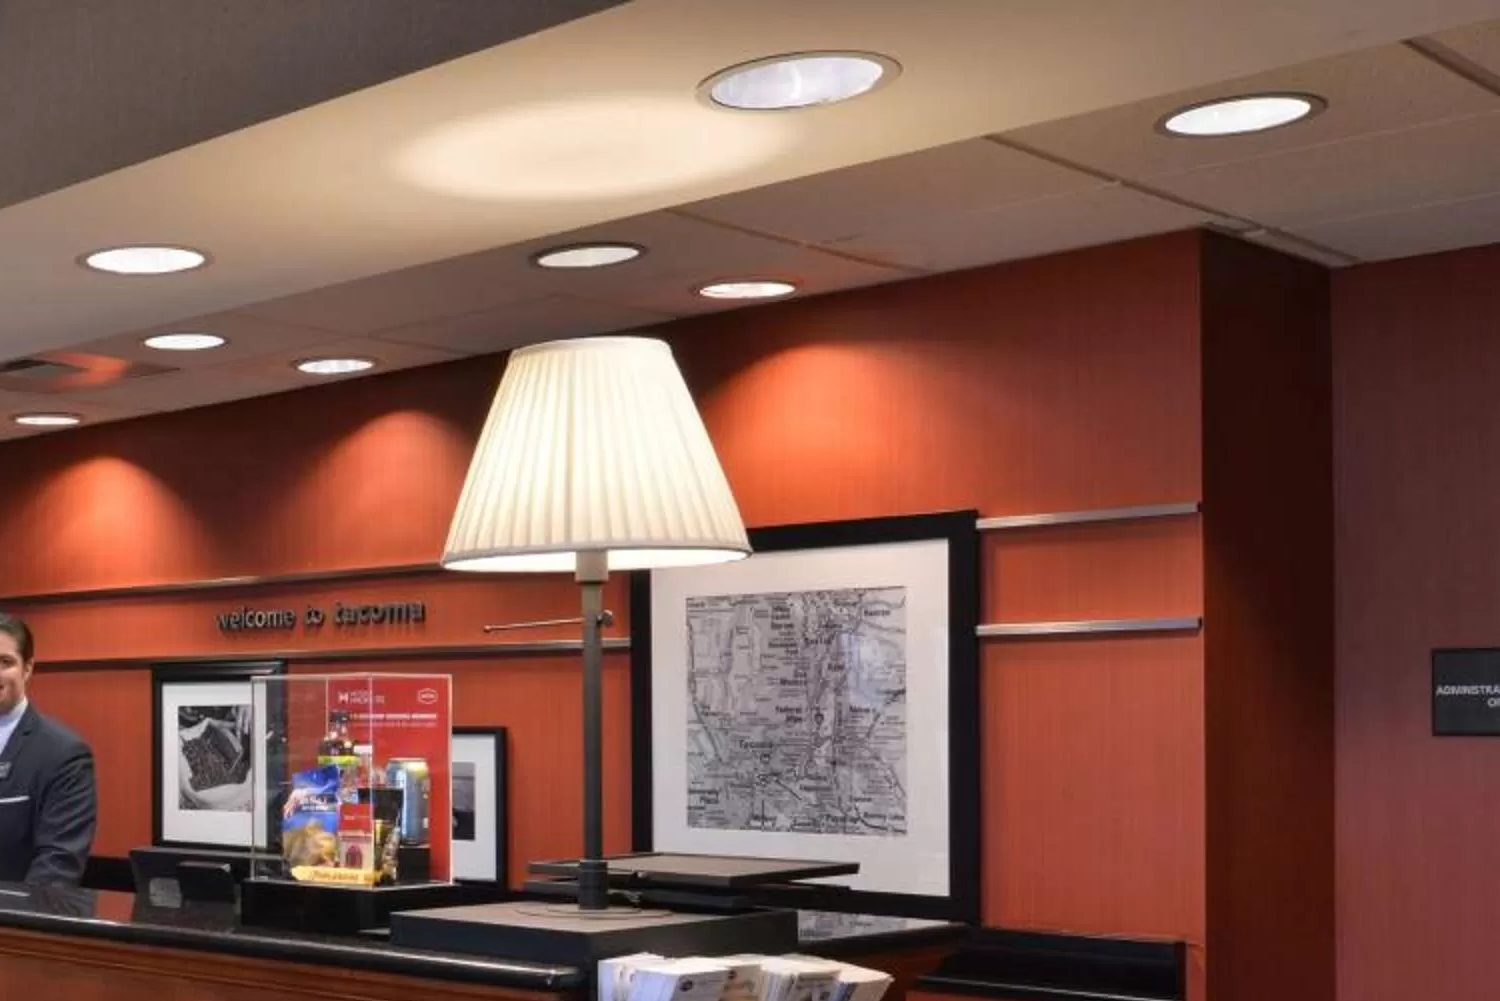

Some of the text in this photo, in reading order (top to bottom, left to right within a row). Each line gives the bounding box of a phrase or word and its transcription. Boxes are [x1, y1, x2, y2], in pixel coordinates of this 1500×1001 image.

[216, 602, 426, 630] welcome to tacoma
